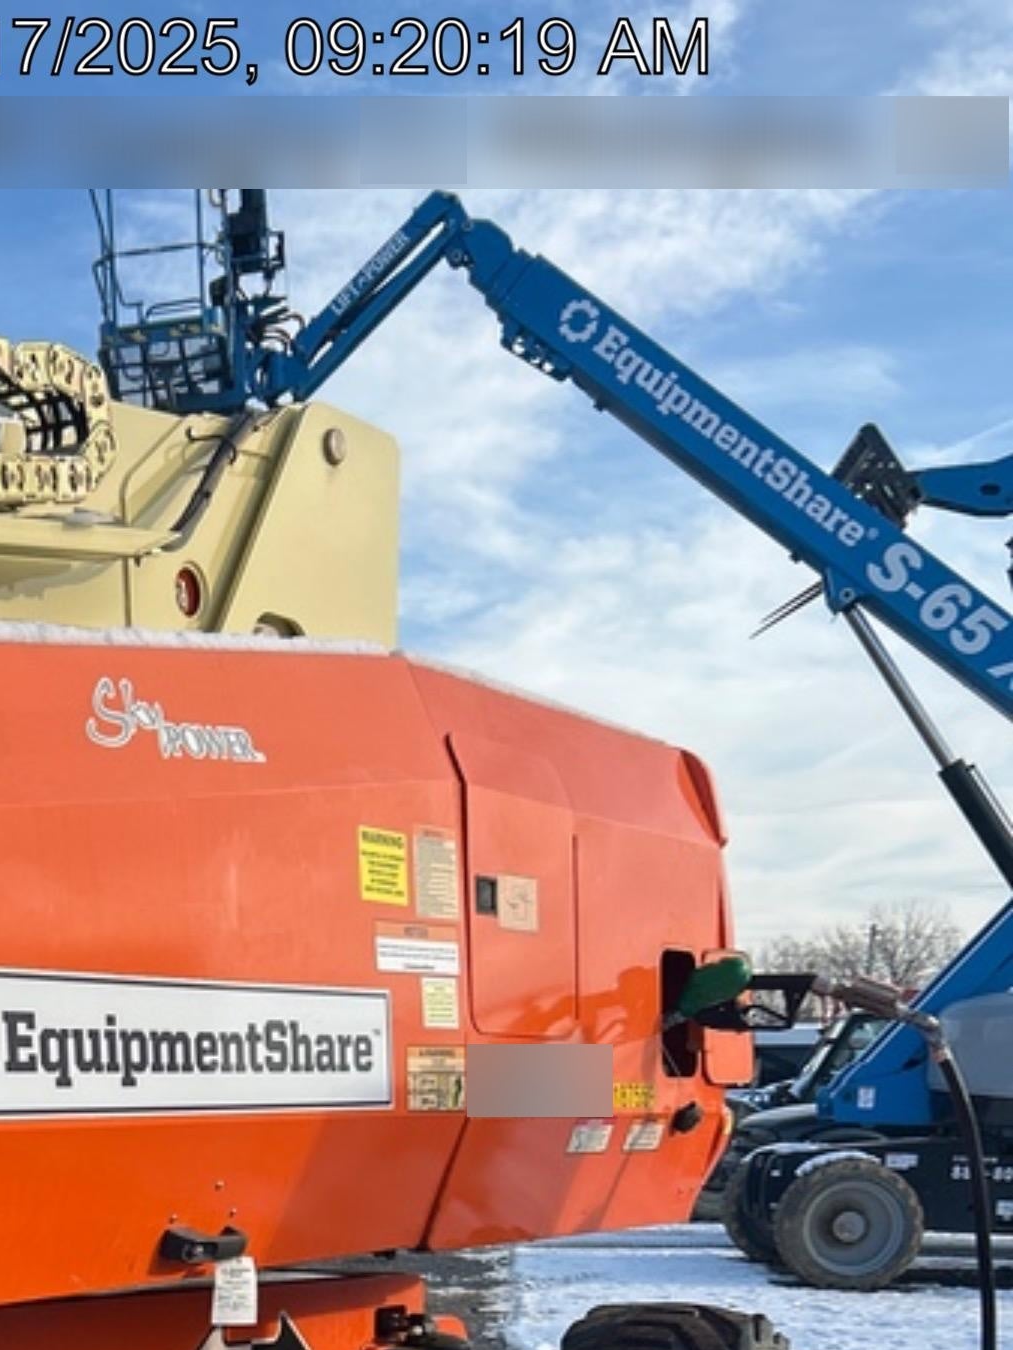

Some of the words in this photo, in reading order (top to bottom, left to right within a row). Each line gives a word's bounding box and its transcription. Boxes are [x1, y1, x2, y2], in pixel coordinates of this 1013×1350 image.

[593, 324, 866, 547] EquipmentShare
[866, 542, 1009, 655] S-65
[1, 1010, 374, 1088] EquipmentShare
